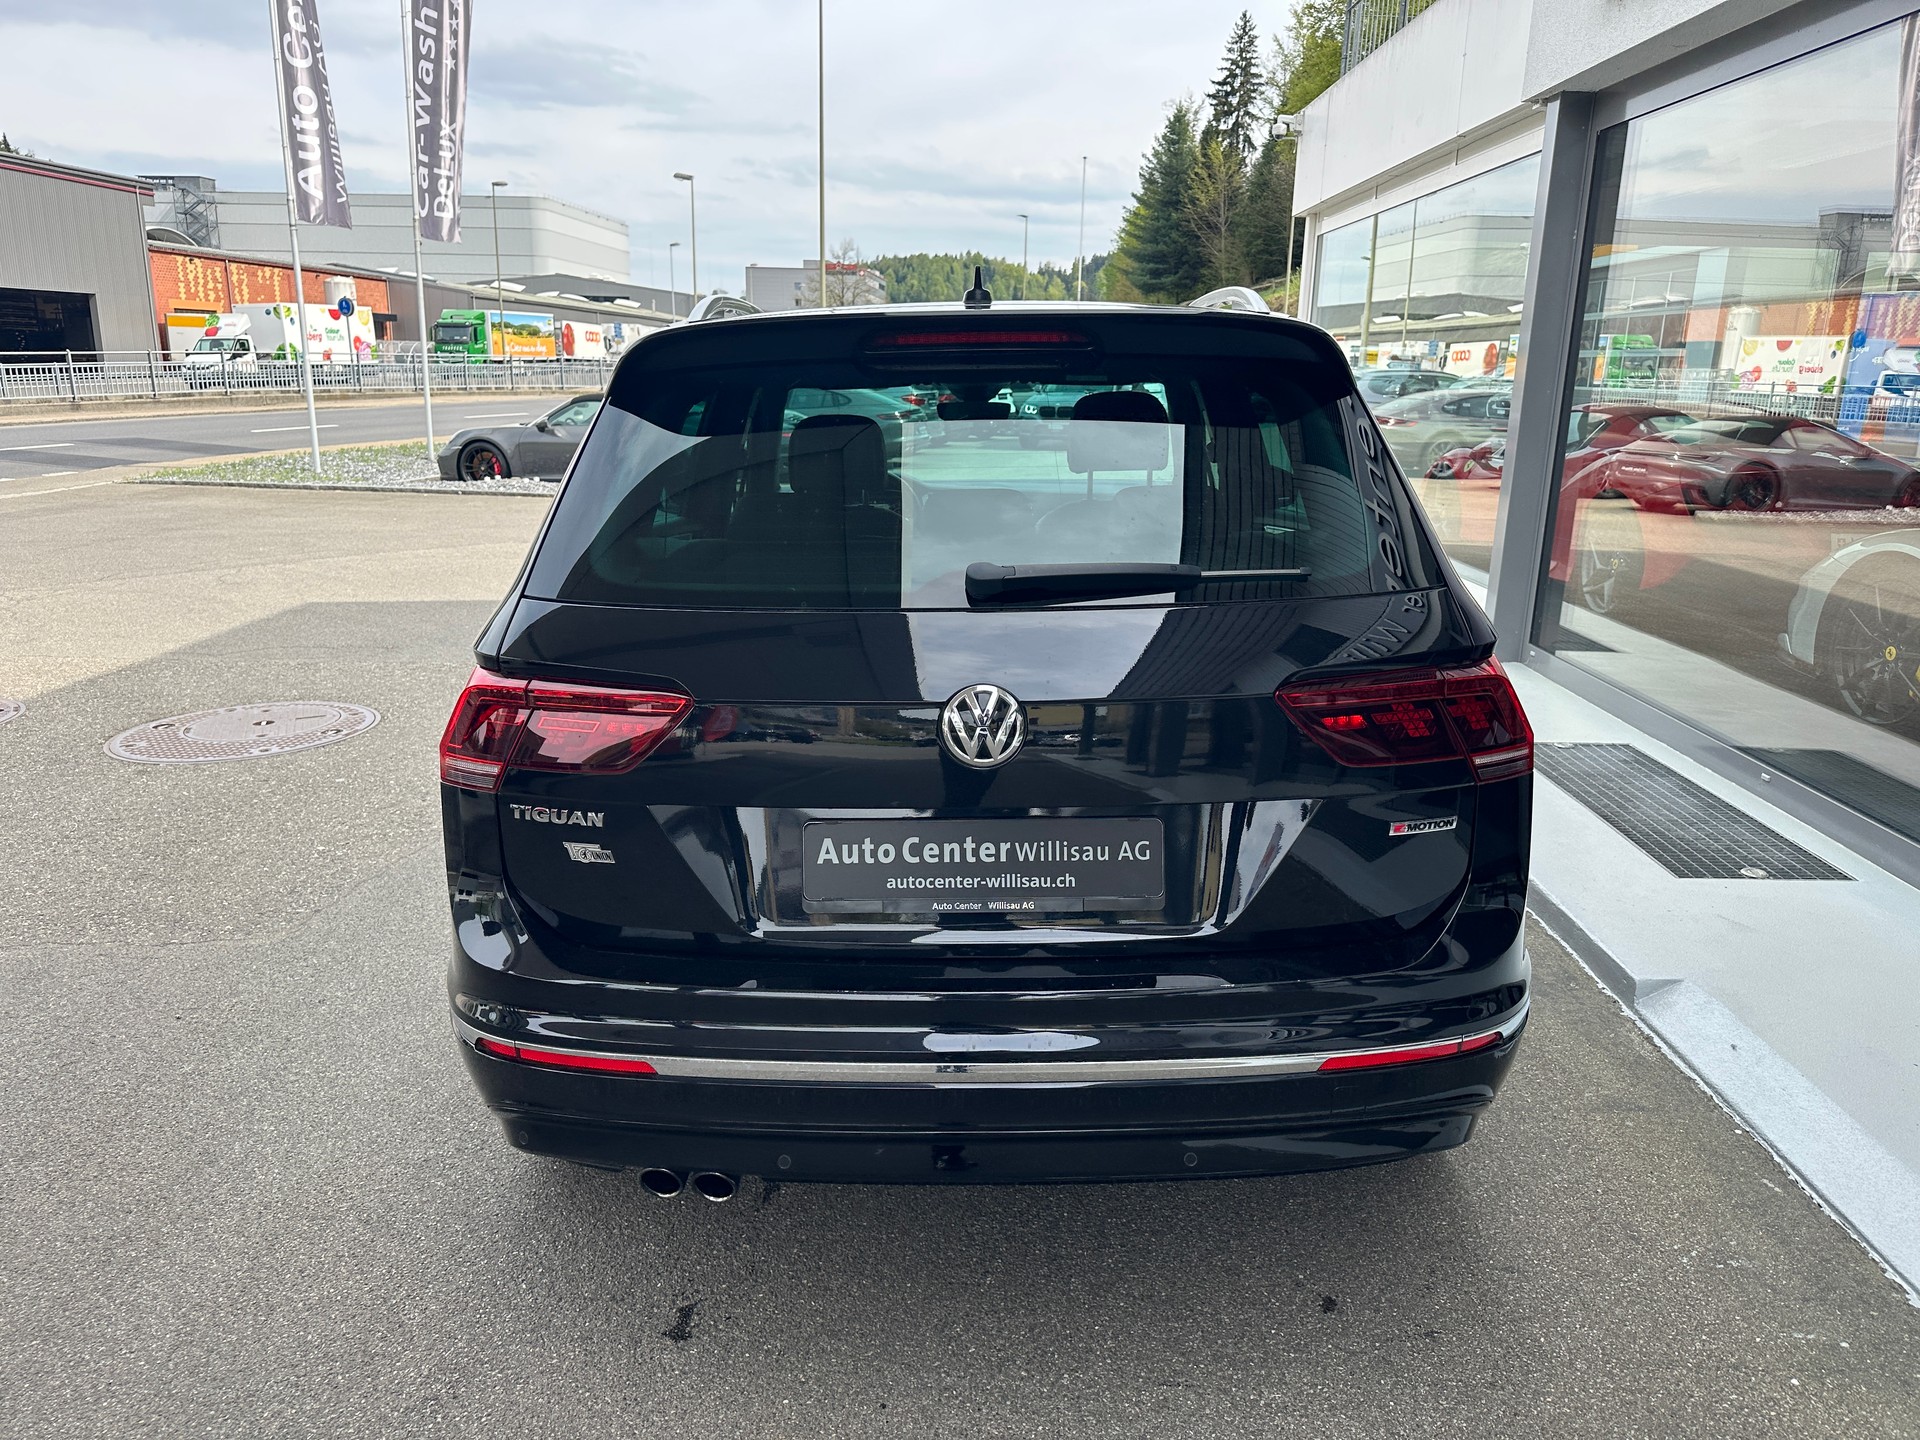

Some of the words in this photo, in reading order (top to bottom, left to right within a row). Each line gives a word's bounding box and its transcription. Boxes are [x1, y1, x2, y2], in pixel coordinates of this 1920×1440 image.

[283, 0, 313, 69] Ce
[292, 85, 324, 200] Auto
[322, 83, 347, 203] Willisau
[510, 803, 605, 828] TIGUAN
[816, 837, 895, 865] Auto
[902, 835, 1010, 864] Center
[1014, 840, 1110, 862] Willisau
[1118, 840, 1151, 861] AG
[886, 873, 1076, 889] autocenter-willisau.ch
[932, 902, 953, 910] Auto
[954, 902, 982, 910] Center
[987, 901, 1021, 910] Willisau
[1022, 901, 1035, 910] AG
